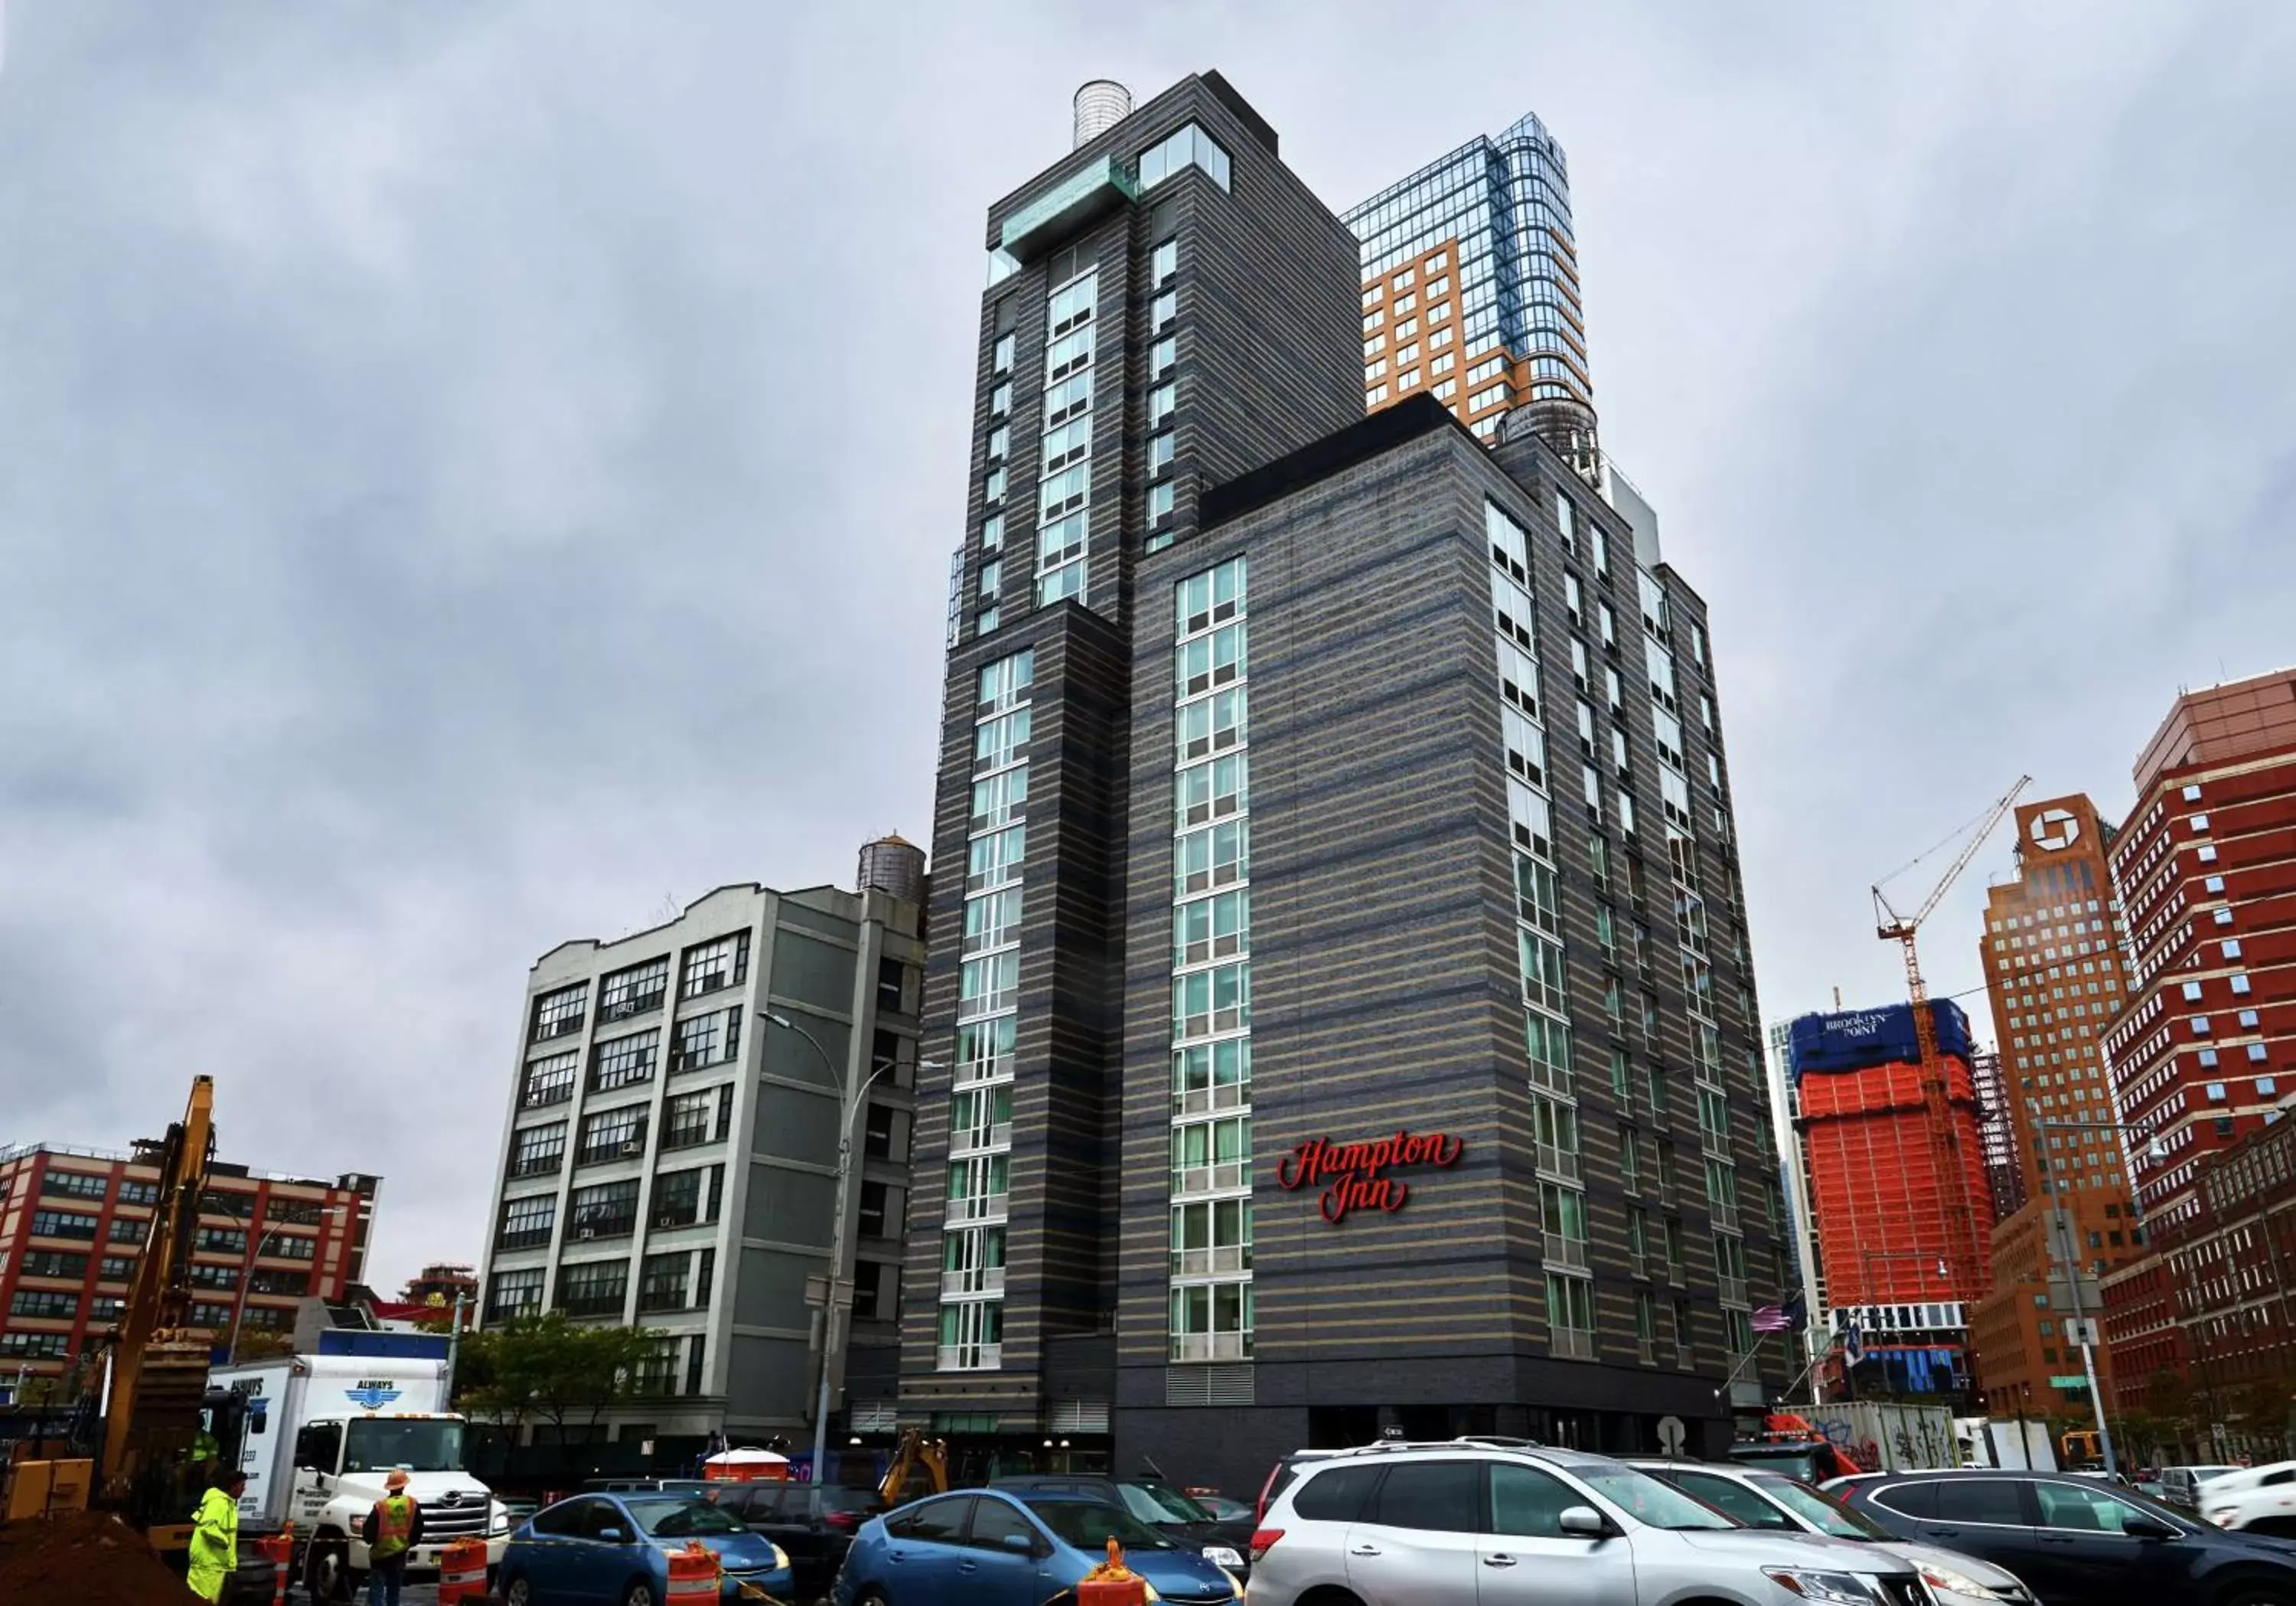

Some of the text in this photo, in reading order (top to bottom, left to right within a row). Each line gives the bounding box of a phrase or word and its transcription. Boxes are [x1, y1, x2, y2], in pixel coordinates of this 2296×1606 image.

[1826, 1013, 1894, 1030] BROOKLYN
[1844, 1023, 1876, 1037] POINT
[1277, 1129, 1463, 1191] Hampton
[1319, 1172, 1409, 1225] Inn
[231, 1378, 263, 1396] ALWAYS
[357, 1380, 393, 1389] ALWAYS
